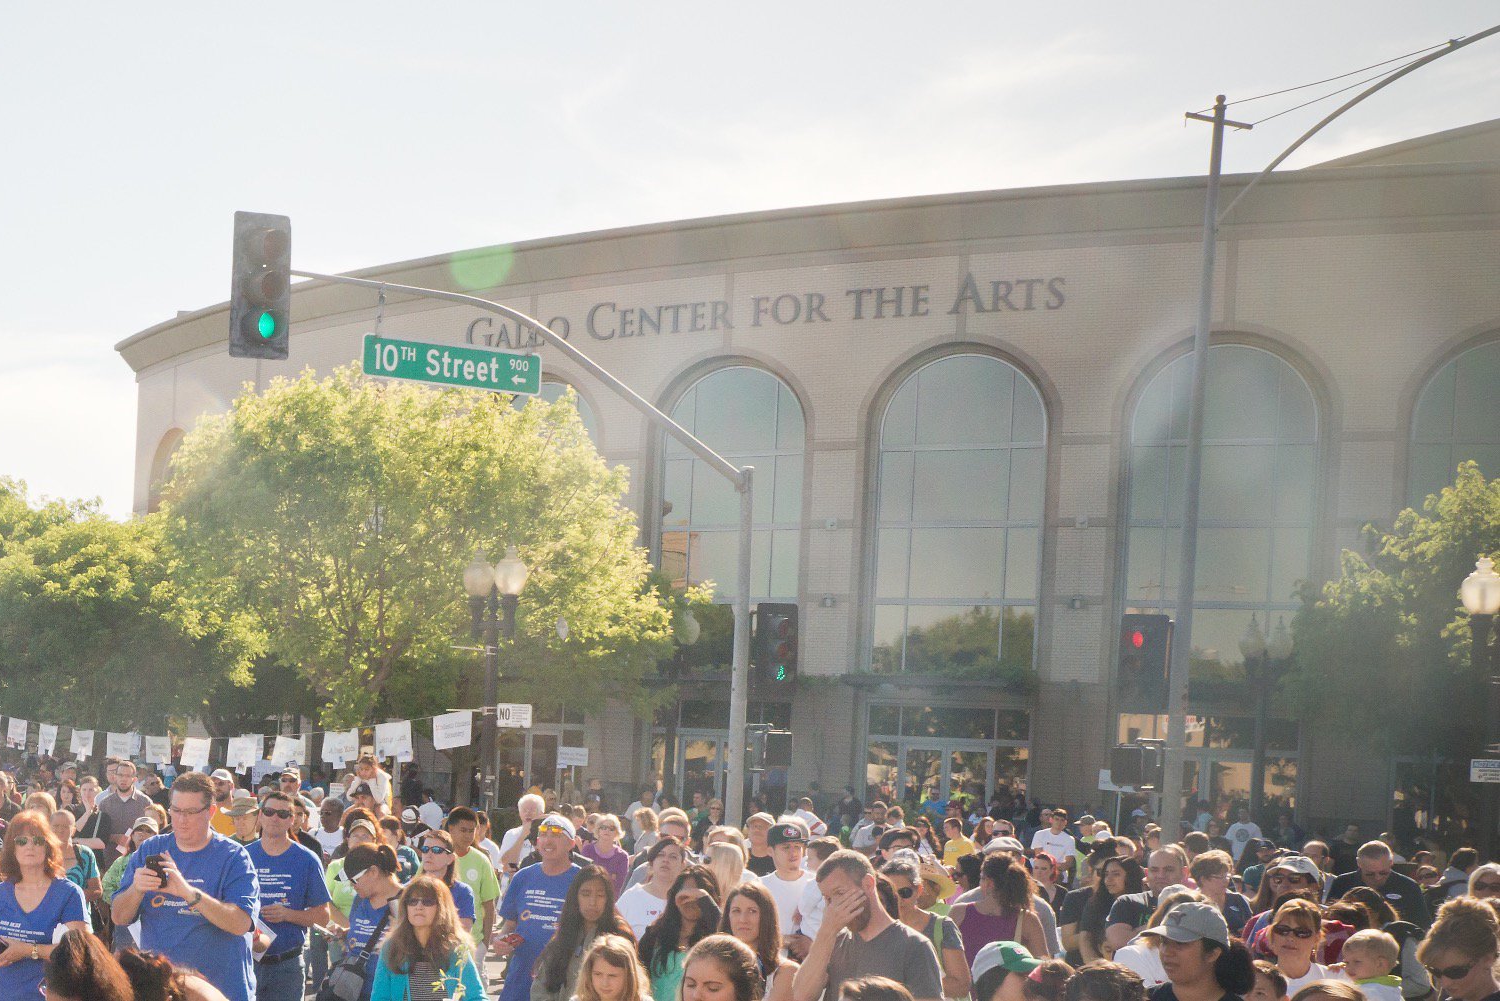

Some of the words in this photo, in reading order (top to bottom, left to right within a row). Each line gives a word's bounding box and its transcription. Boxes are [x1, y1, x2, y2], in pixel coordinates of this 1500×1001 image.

[586, 302, 734, 341] CENTER
[750, 293, 831, 327] FOR
[846, 284, 930, 320] THE
[946, 271, 1067, 315] ARTS
[374, 343, 416, 372] 10TH
[425, 349, 499, 383] Street
[509, 358, 529, 372] 900
[499, 708, 511, 720] NO
